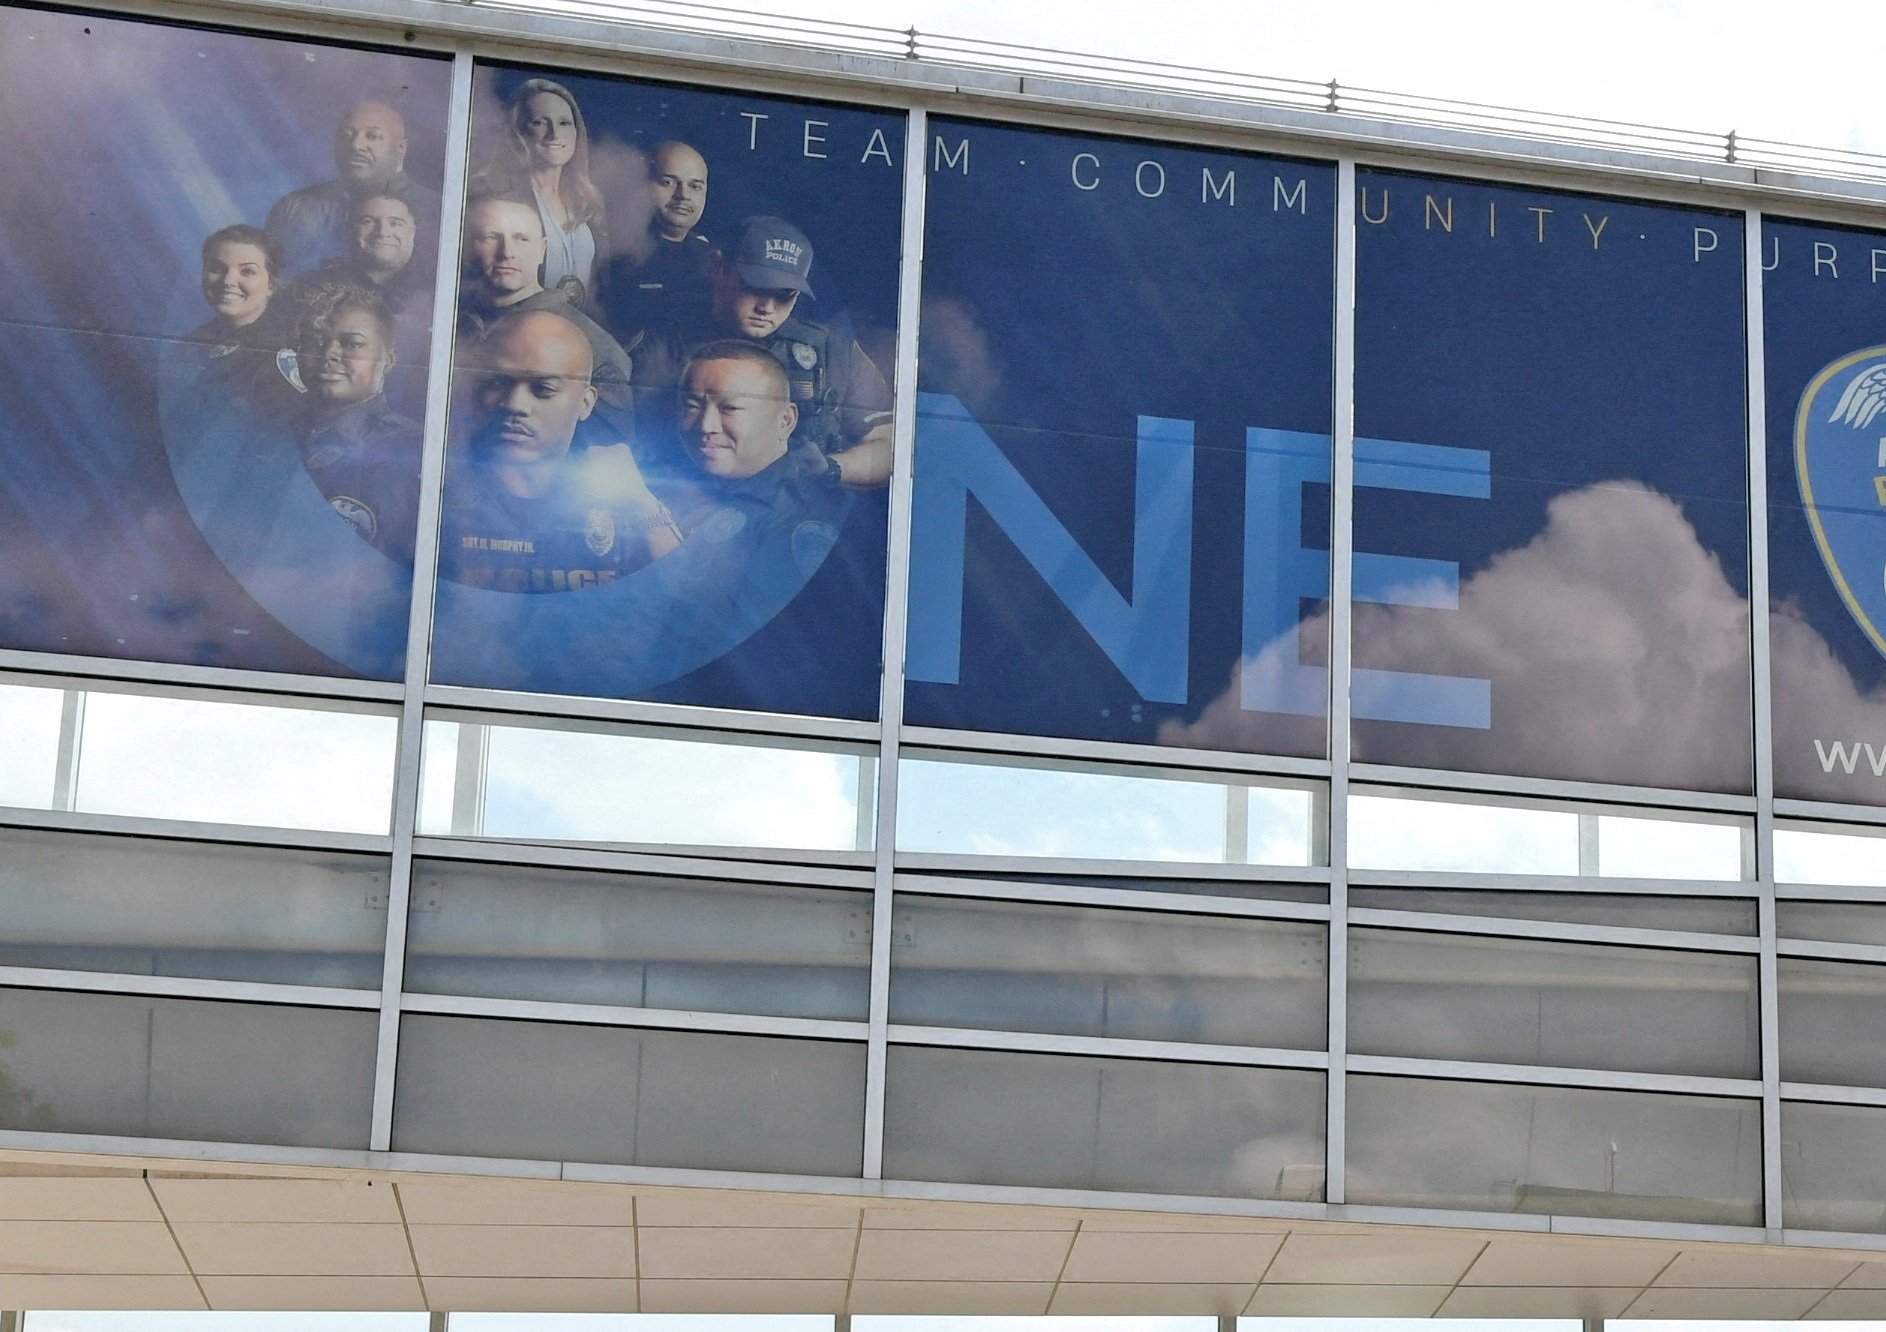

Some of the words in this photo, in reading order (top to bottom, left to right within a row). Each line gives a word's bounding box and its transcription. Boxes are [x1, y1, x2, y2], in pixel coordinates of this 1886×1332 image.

[740, 112, 970, 176] TEAM
[1071, 152, 1610, 251] COMMUNITY
[765, 239, 803, 258] AKRON
[765, 251, 798, 266] POLICE
